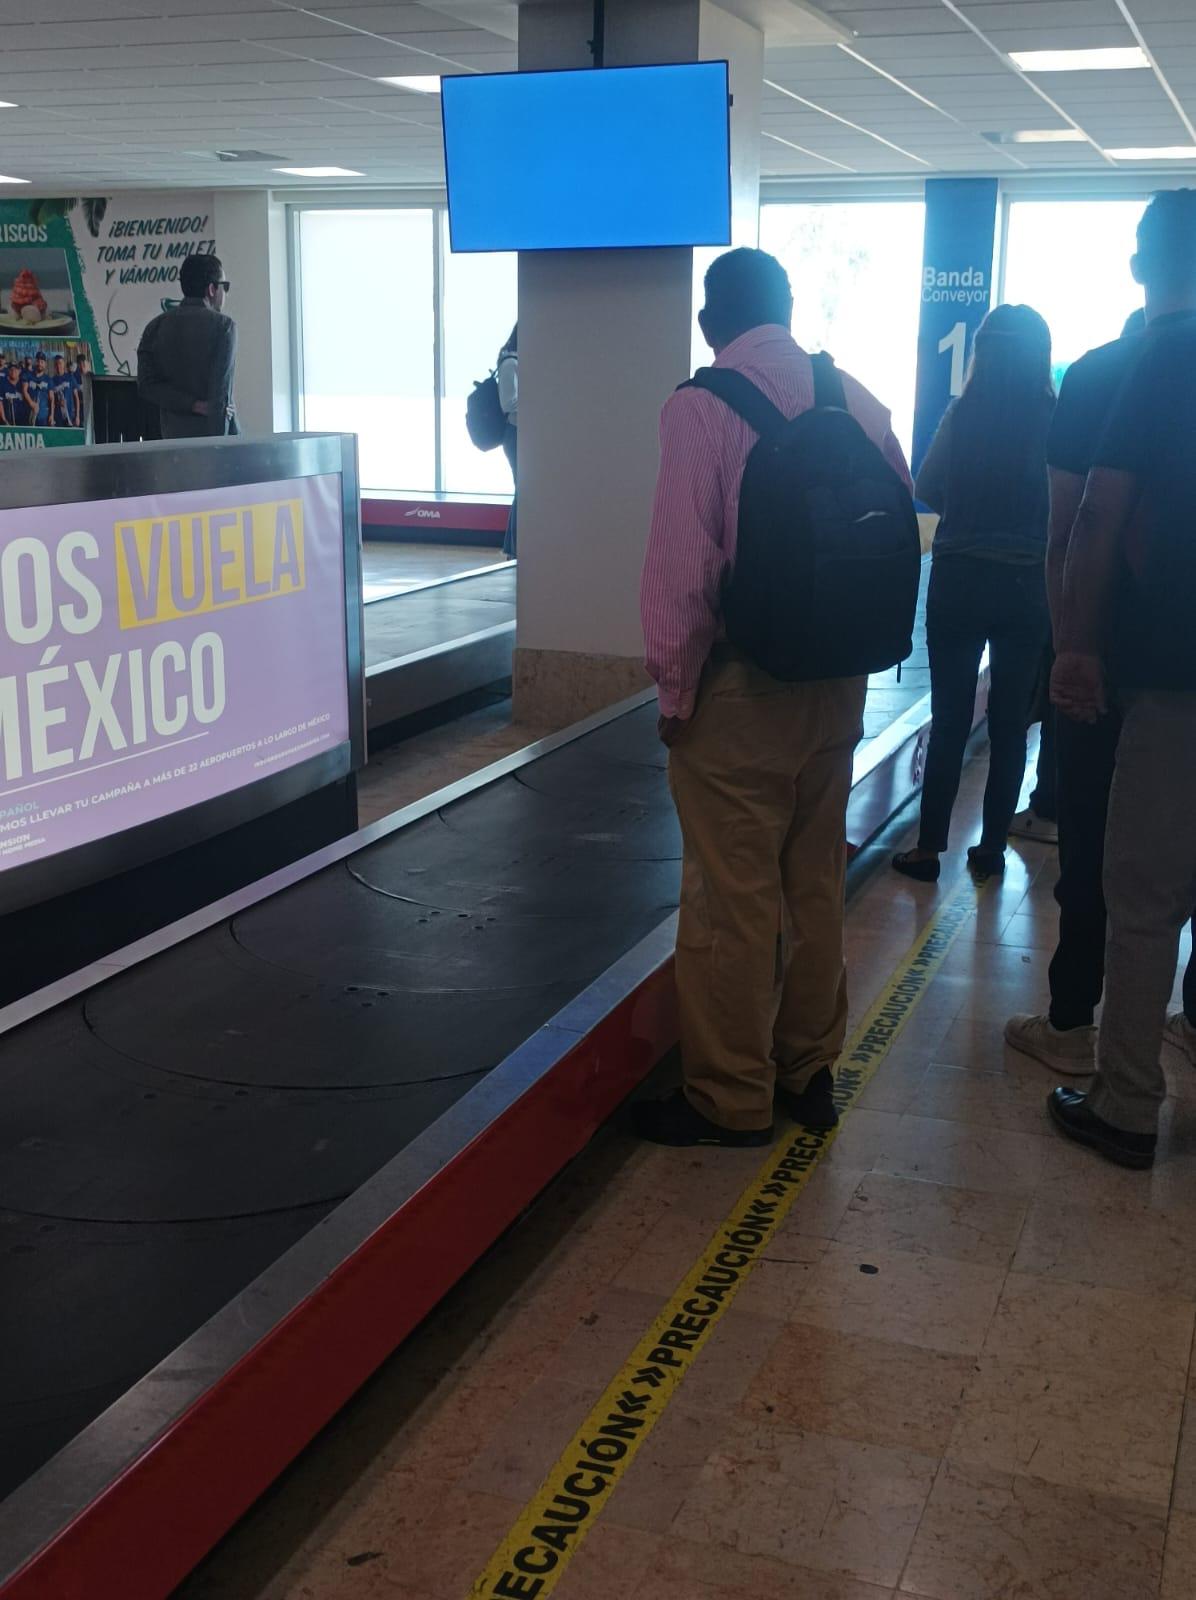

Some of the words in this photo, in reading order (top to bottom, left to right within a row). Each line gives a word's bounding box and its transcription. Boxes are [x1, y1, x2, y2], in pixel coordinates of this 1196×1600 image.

[108, 215, 208, 238] ¡BIENVENIDO!
[97, 244, 137, 263] TOMA
[142, 243, 162, 260] TU
[105, 268, 116, 285] Y
[923, 267, 984, 287] Banda
[921, 287, 989, 305] Conveyor
[938, 322, 966, 397] 1
[1, 531, 103, 645] OS
[121, 504, 300, 623] VUELA
[29, 803, 73, 824] LLEVAR
[75, 799, 89, 810] TU
[91, 781, 142, 804] CAMPAÑA
[143, 779, 151, 788] A
[152, 770, 172, 785] MÁS
[174, 766, 187, 777] DE
[188, 762, 199, 773] 22
[199, 741, 257, 769] AEROPUERTOS
[257, 739, 263, 747] A
[263, 735, 274, 745] LO
[297, 722, 307, 732] DE
[307, 713, 331, 727] MÉXICO
[490, 1412, 646, 1600] ECAUCIÓN
[648, 1211, 775, 1367] PRECAUCIÓN
[857, 973, 927, 1055] PRECAUCIÓN
